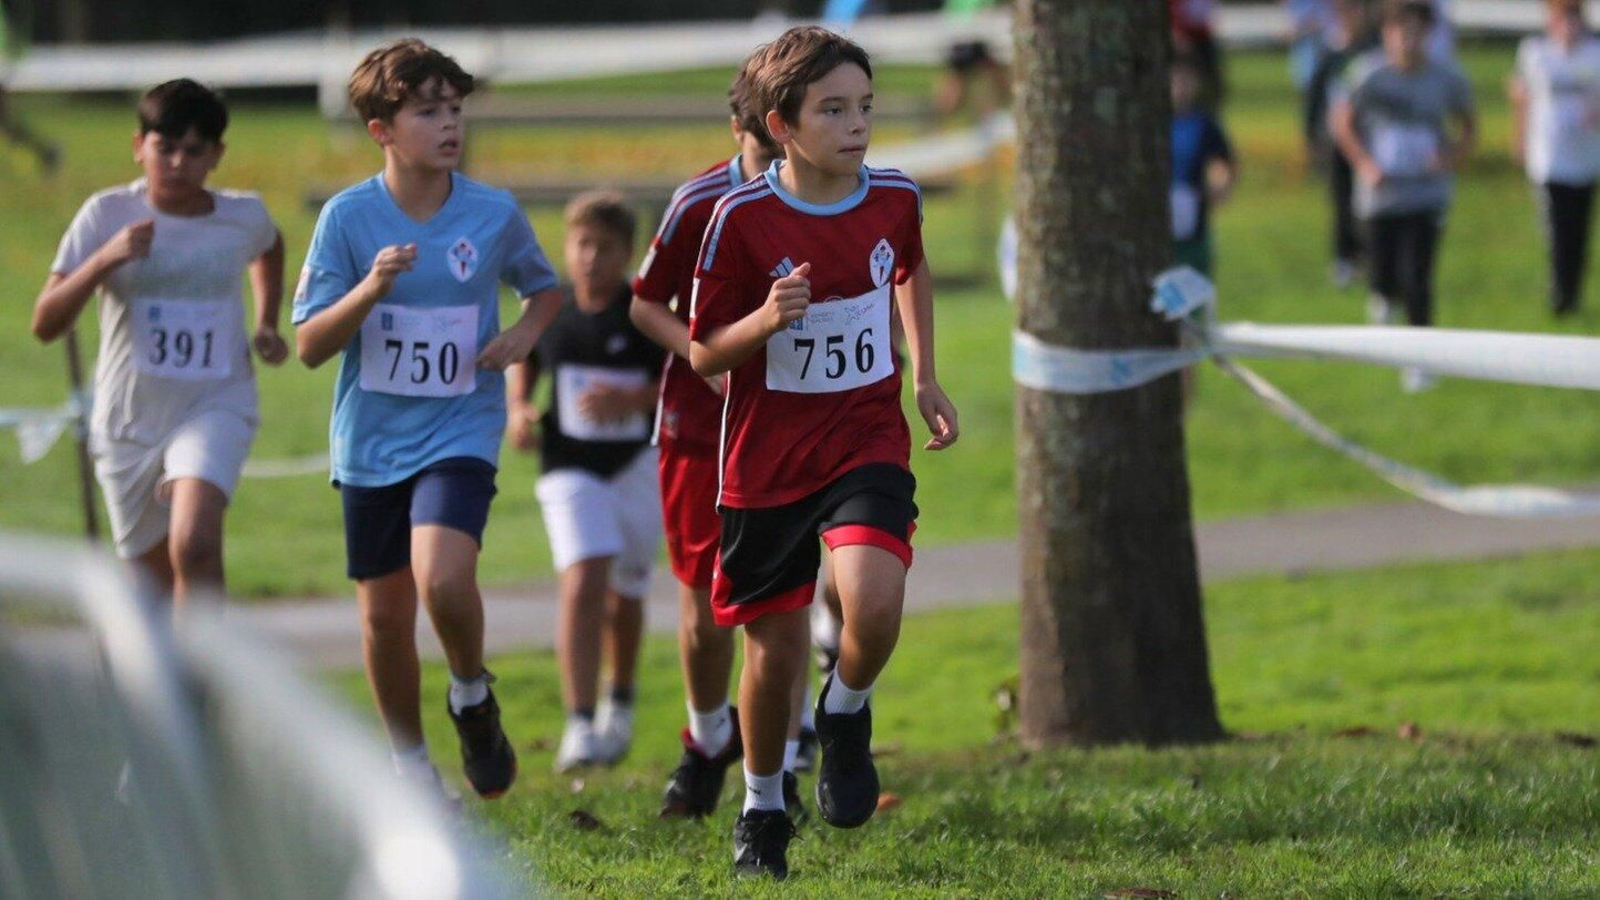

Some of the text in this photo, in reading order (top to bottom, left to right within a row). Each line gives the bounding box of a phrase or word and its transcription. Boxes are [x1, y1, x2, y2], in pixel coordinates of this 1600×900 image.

[149, 327, 214, 368] 391
[385, 339, 459, 385] 750
[794, 328, 875, 381] 756
